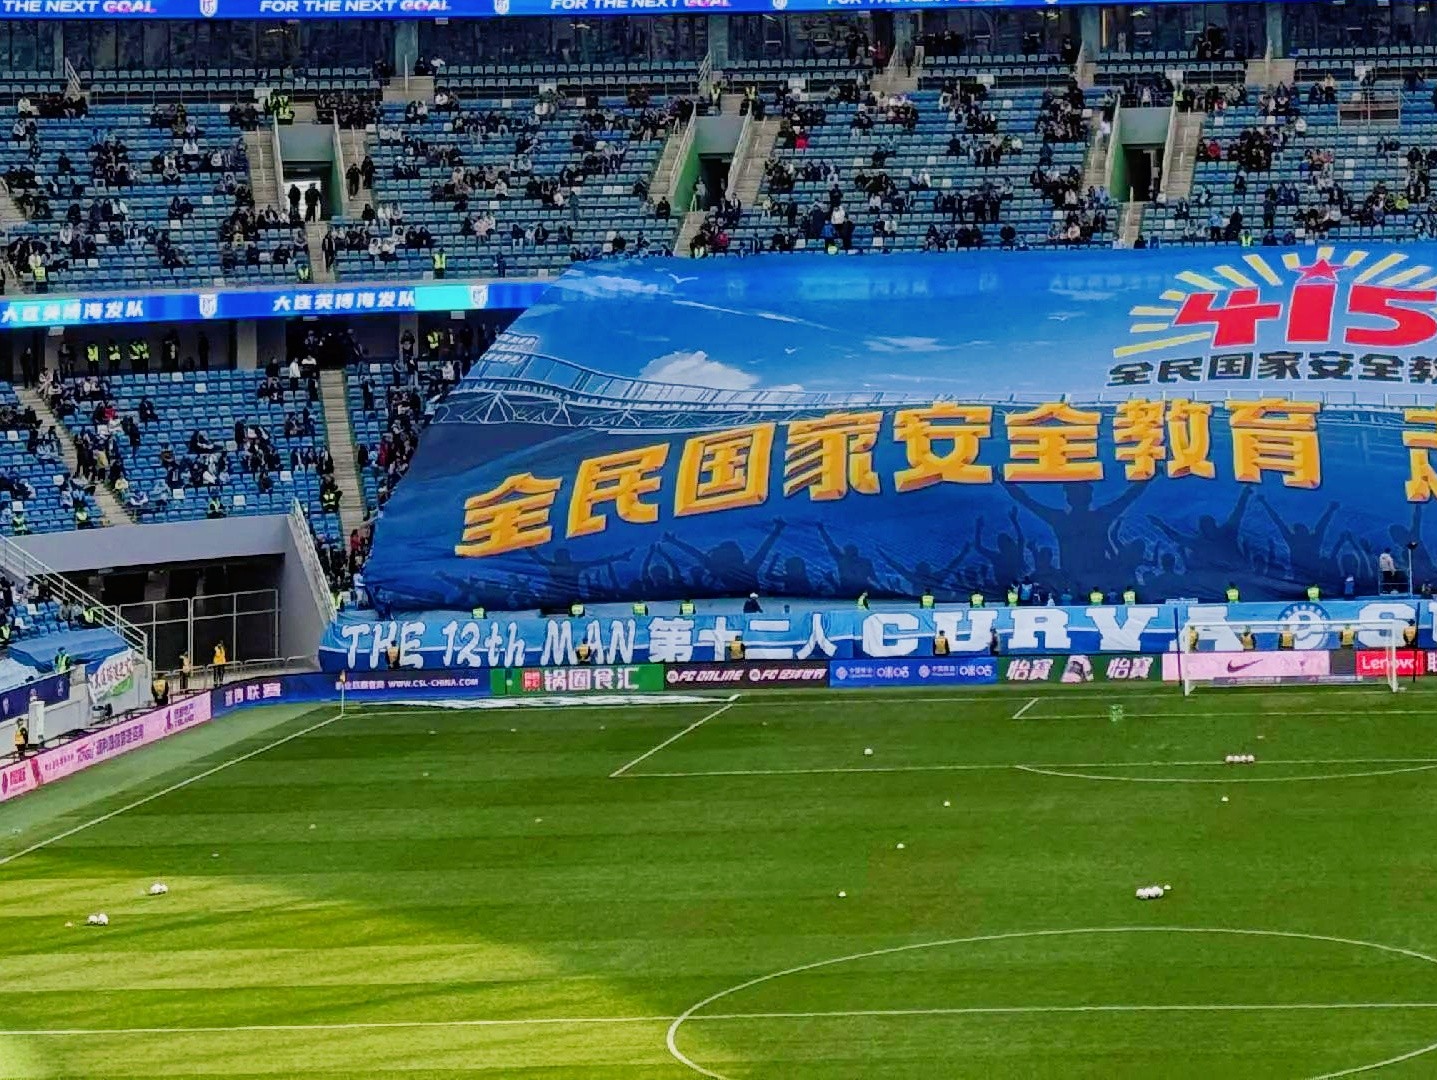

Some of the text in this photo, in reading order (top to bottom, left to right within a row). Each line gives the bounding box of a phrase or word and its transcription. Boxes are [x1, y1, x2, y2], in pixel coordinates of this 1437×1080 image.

[3, 0, 157, 13] THE NEXT GOAL
[260, 0, 452, 12] FOR THE NEXT GOAL
[551, 0, 587, 10] FOR
[273, 290, 415, 311] 大连英博海发队
[1, 300, 143, 322] 大连英博海发队
[455, 399, 1322, 557] 全民国家安全教育
[341, 622, 426, 670] THE
[441, 621, 526, 669] 12th
[541, 618, 636, 666] MAN
[648, 613, 838, 663] 第十二人
[862, 605, 1245, 657] CURVA
[388, 679, 479, 688] WWW.CSL-CHINA.COM
[545, 668, 639, 690] 锅圈食汇
[697, 669, 743, 681] ONLINE
